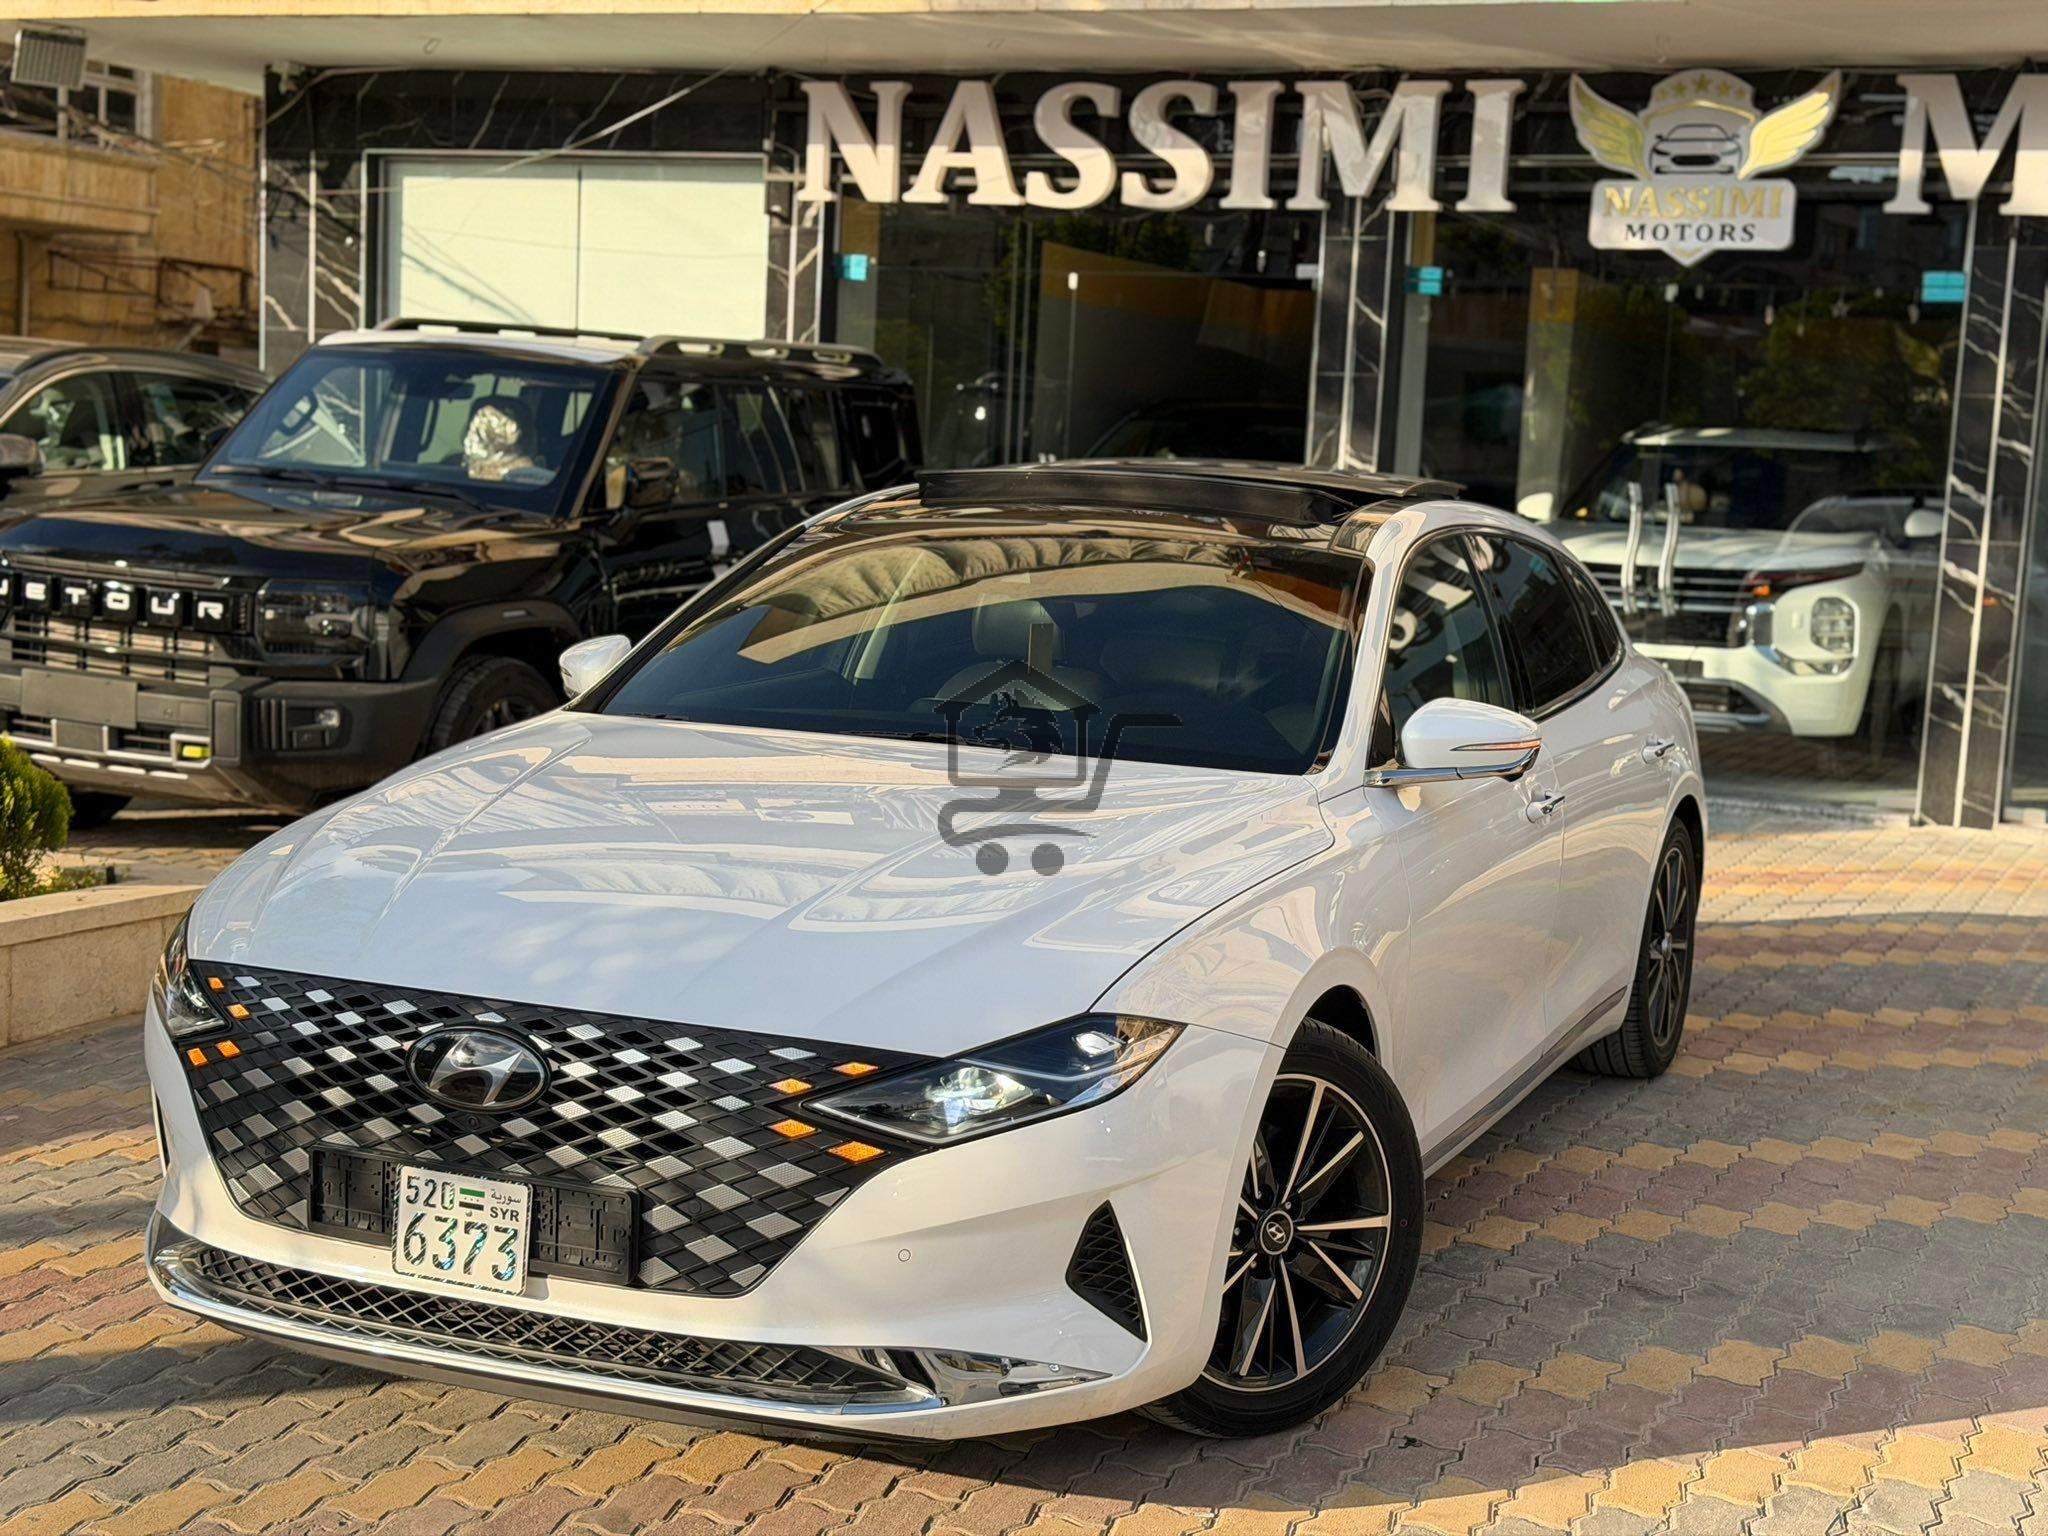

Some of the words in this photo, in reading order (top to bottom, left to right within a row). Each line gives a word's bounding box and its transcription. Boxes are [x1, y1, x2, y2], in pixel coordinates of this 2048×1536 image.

[797, 80, 1527, 213] NASSIMI
[1602, 185, 1785, 219] NASSIMI
[1625, 222, 1757, 242] MOTORS
[405, 1175, 455, 1211] 520
[490, 1188, 522, 1206] سورية
[489, 1206, 520, 1222] SYR
[403, 1212, 518, 1281] 6373
